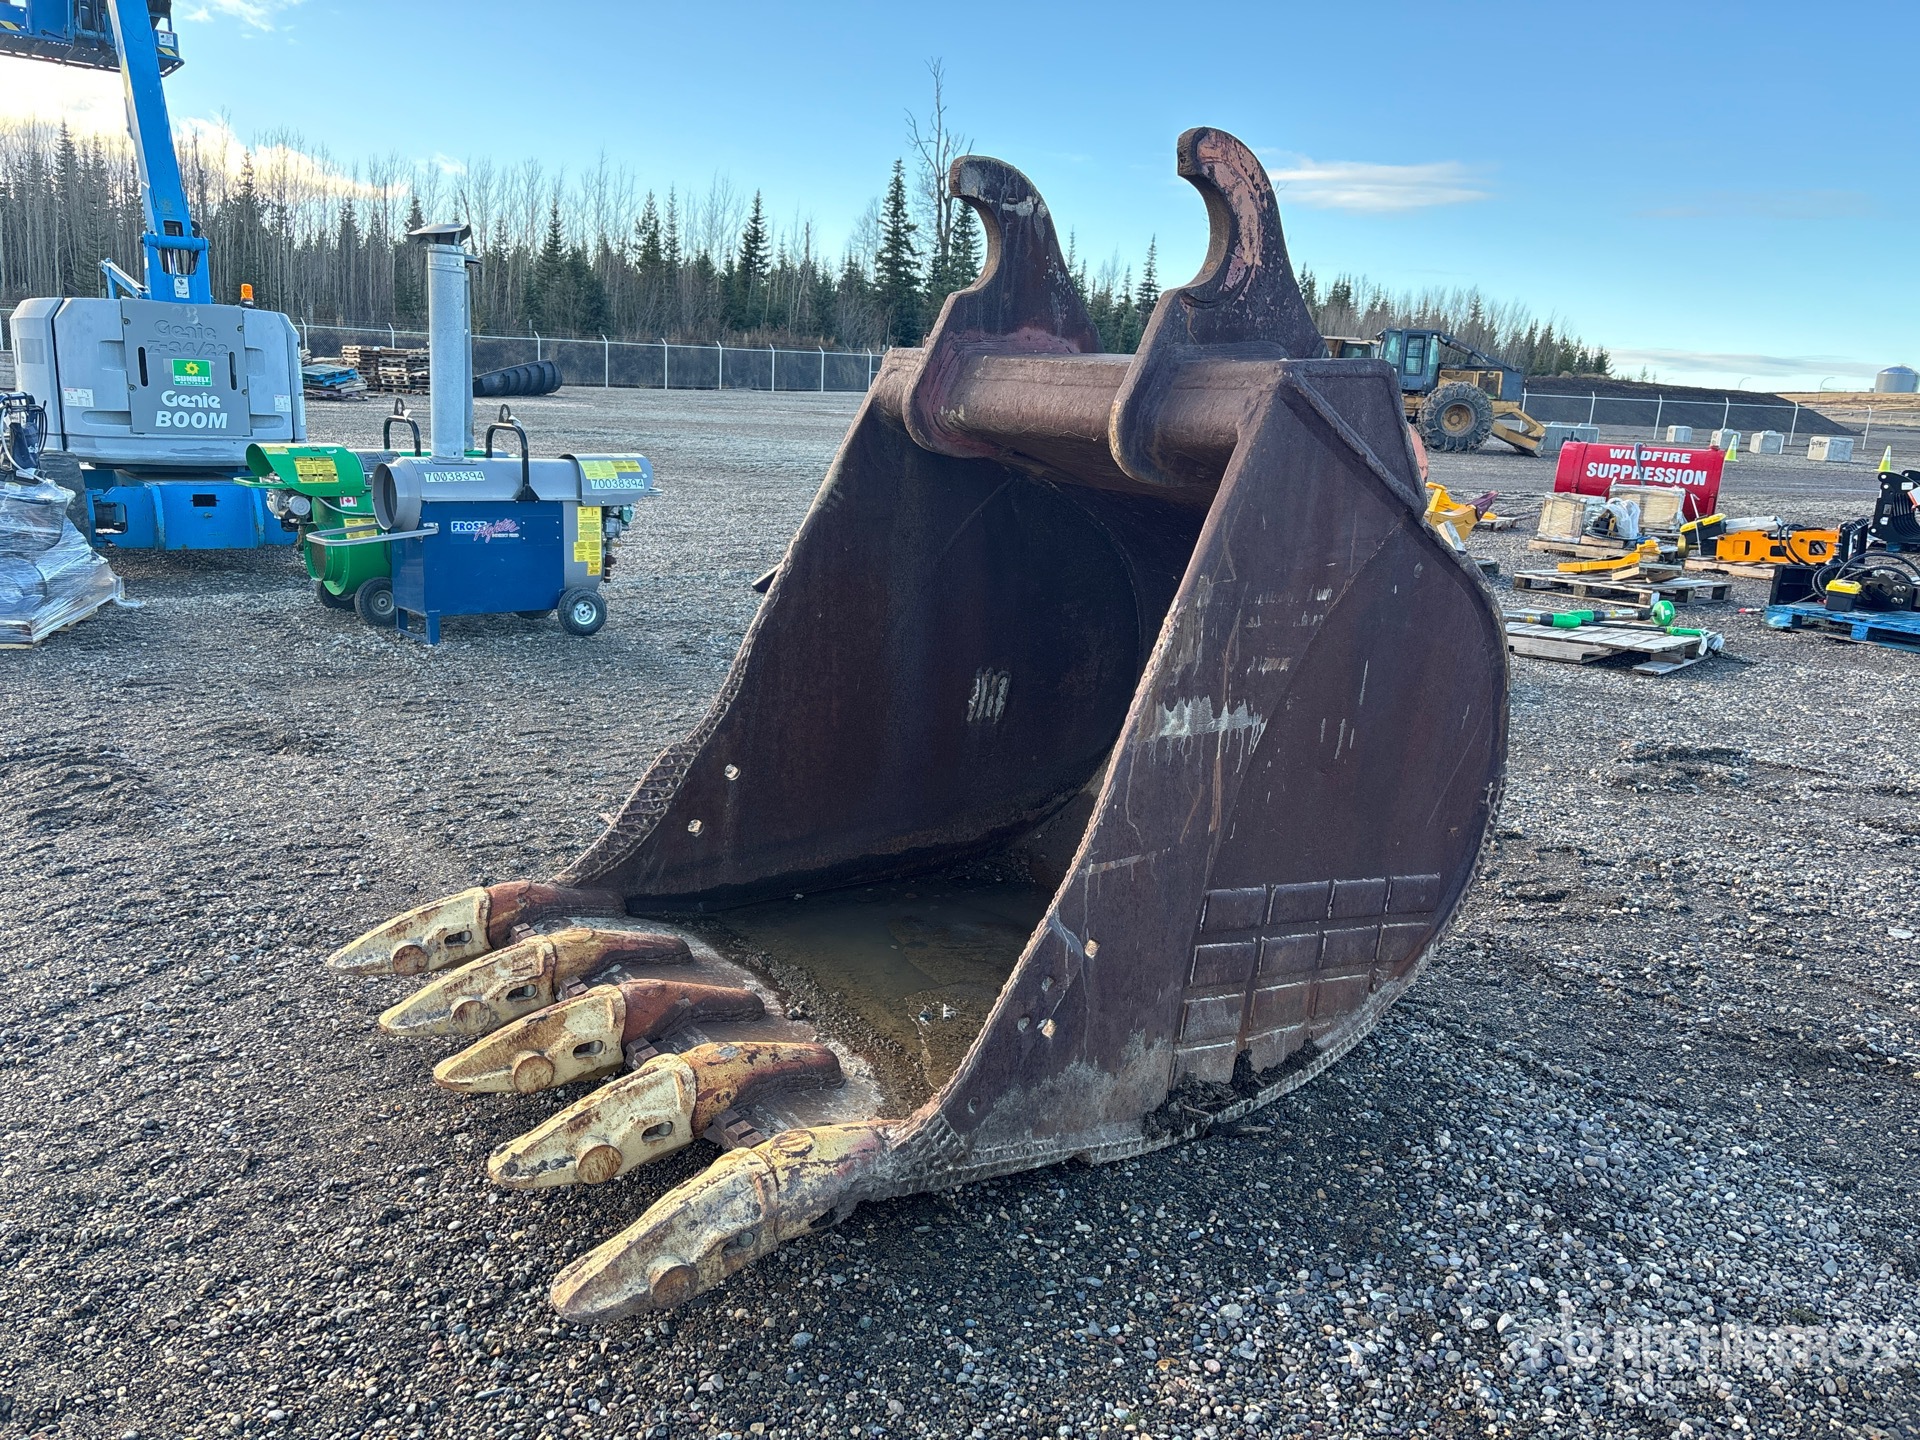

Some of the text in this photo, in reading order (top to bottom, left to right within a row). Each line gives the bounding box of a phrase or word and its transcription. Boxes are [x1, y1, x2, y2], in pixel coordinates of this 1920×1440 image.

[154, 320, 217, 340] Genie
[147, 340, 229, 357] Z-34/22
[174, 375, 210, 383] SUNBELT
[161, 390, 221, 409] Genie
[155, 410, 228, 429] BOOM
[425, 471, 484, 482] 70038394
[591, 478, 644, 488] 70038394
[1586, 462, 1708, 486] SUPPRESSION
